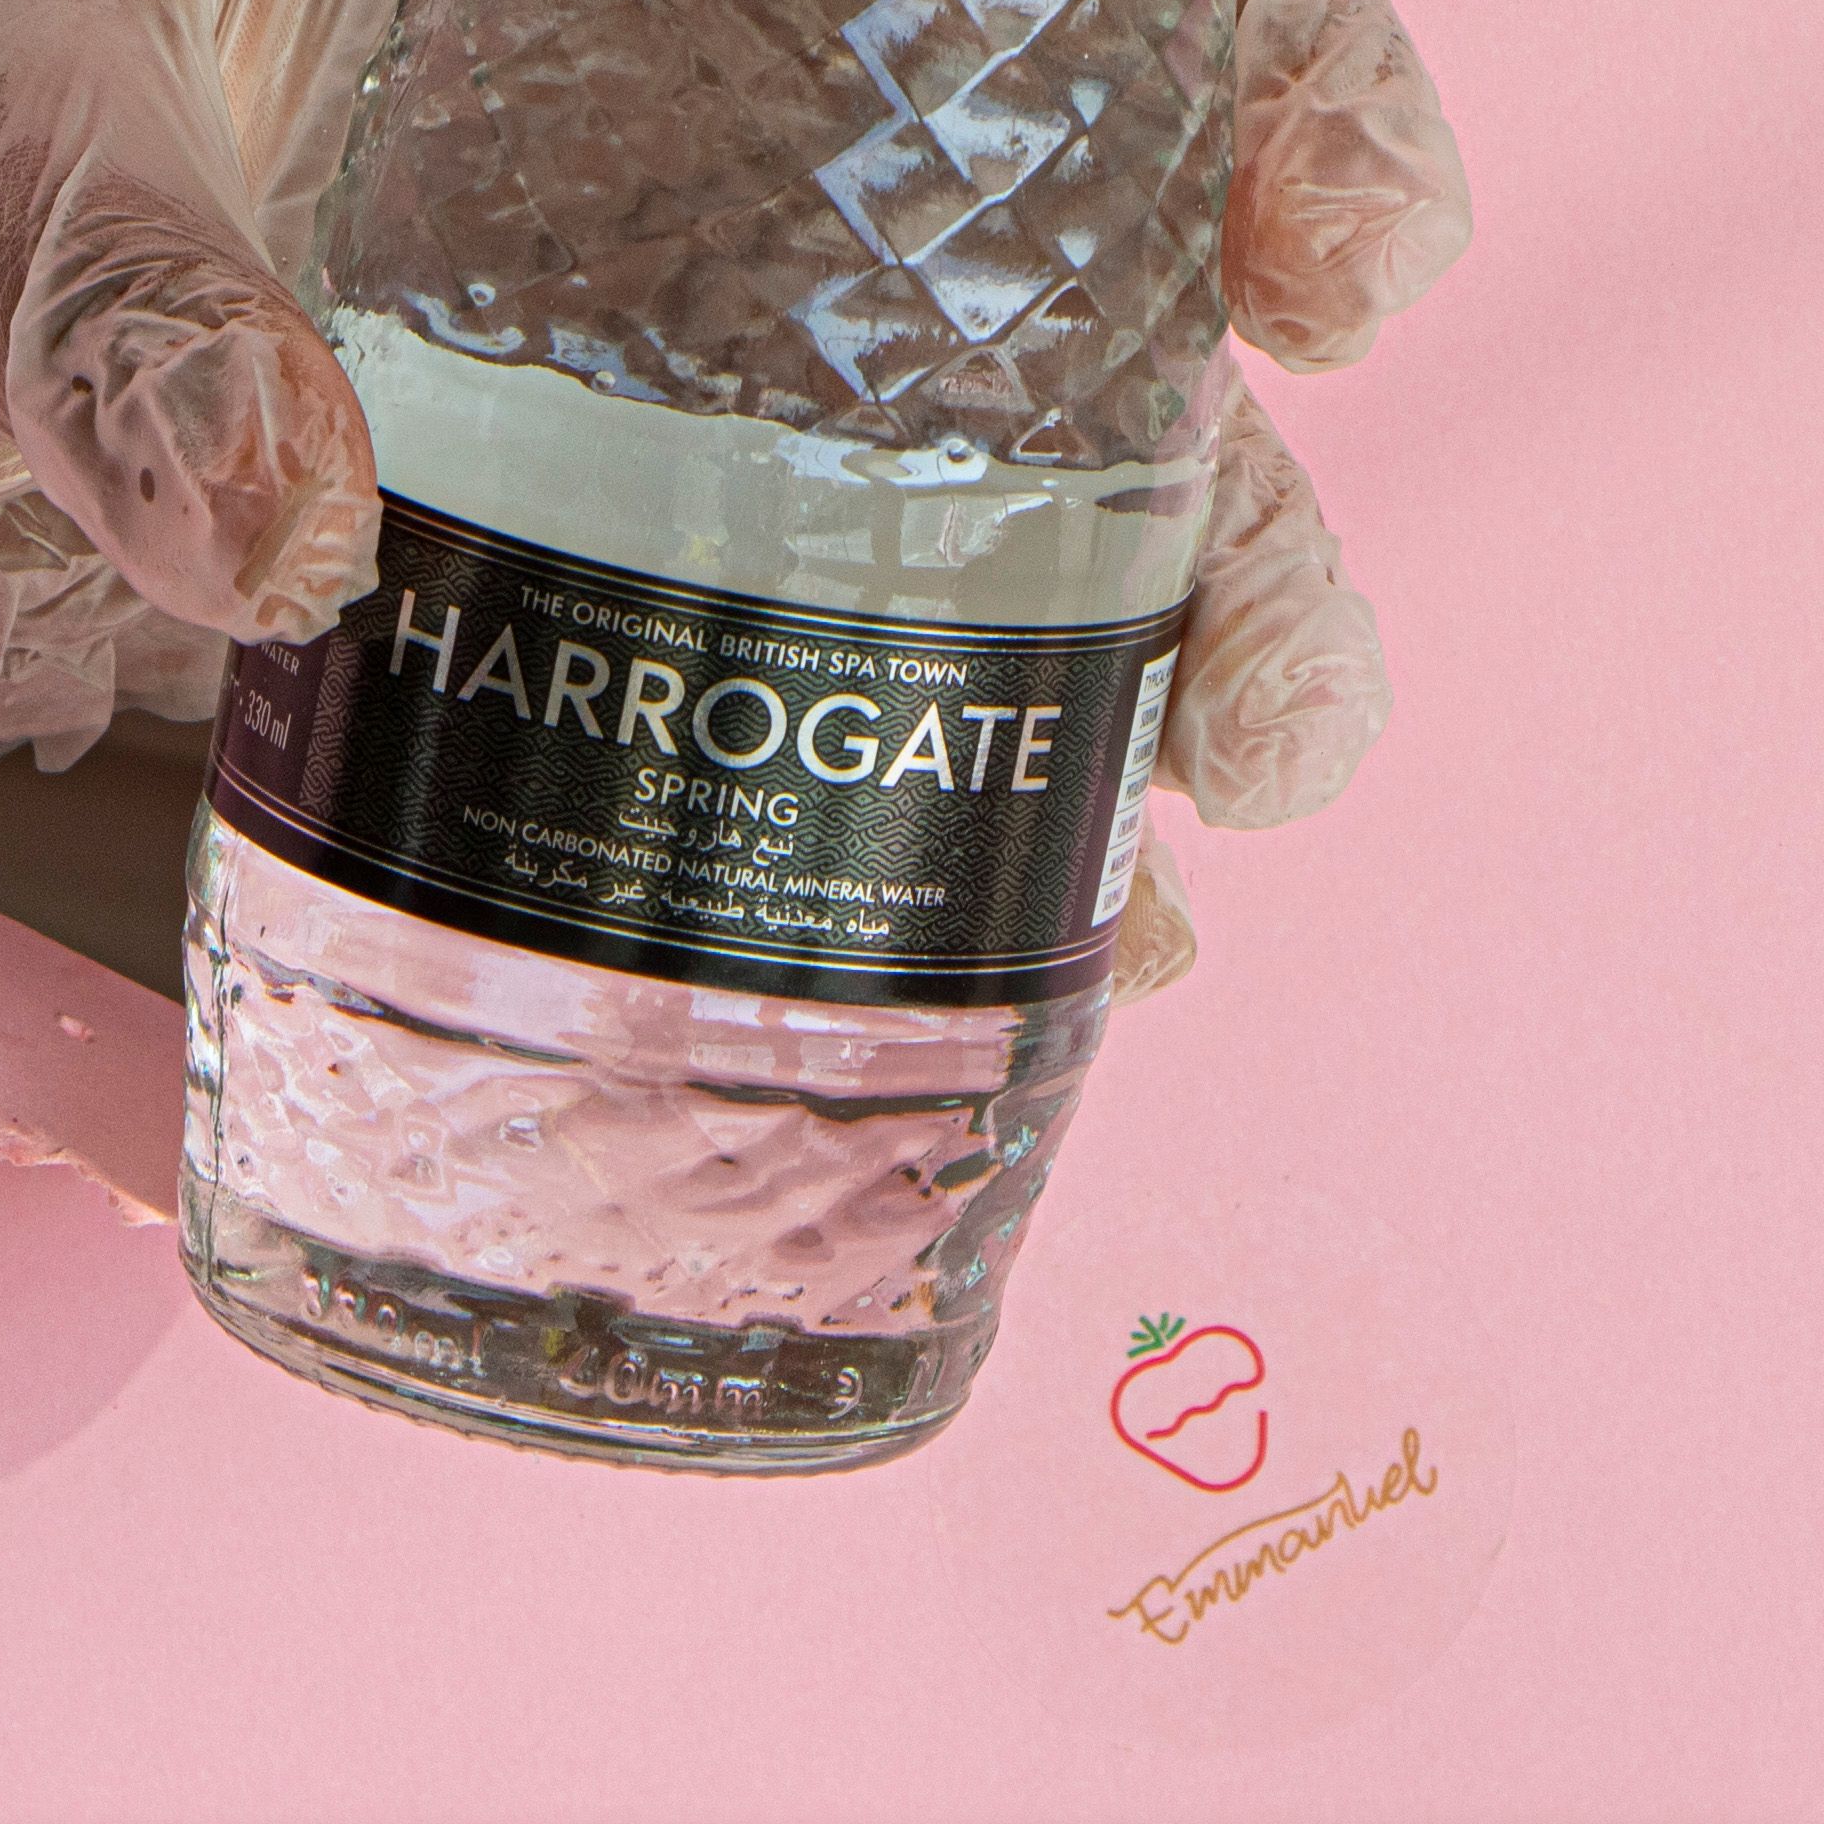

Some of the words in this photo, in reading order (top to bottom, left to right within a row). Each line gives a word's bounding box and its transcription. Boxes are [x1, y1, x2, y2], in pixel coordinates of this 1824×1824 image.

[521, 584, 566, 618] THE
[572, 601, 708, 653] ORIGINAL
[719, 634, 821, 673] BRITISH
[828, 650, 877, 679] SPA
[886, 656, 968, 688] TOWN
[244, 689, 272, 738] 330
[388, 588, 1063, 794] HARROGATE
[634, 766, 800, 828] SPRING
[462, 803, 517, 837] NON
[522, 821, 672, 874] CARBONATED
[677, 856, 779, 894] NATURAL
[782, 874, 876, 905] MINERAL
[881, 880, 946, 909] WATER
[1107, 1427, 1438, 1645] Emmanuel
